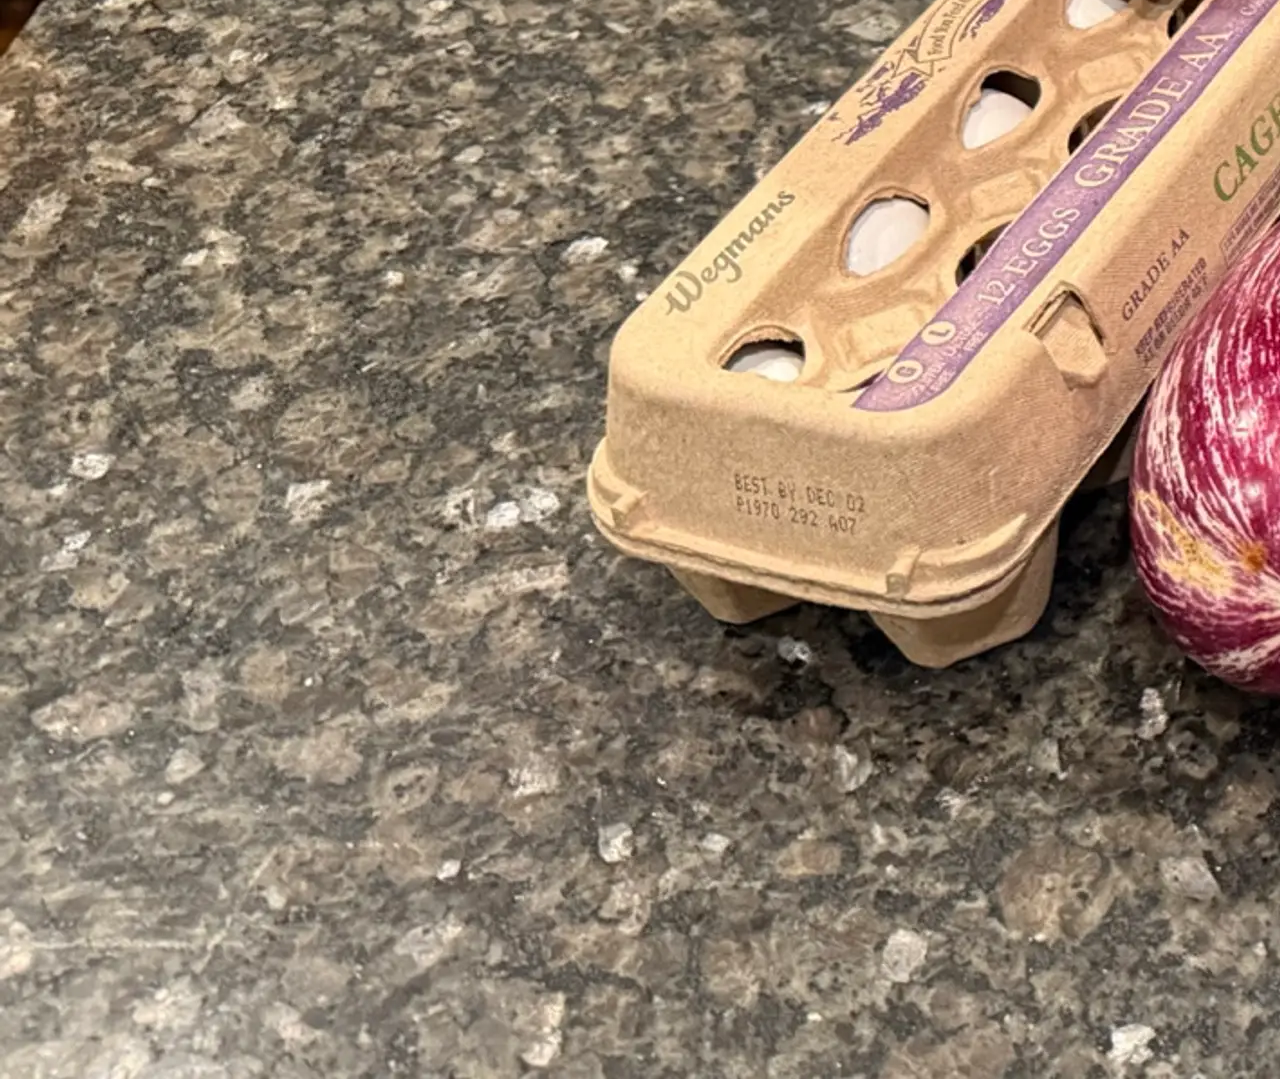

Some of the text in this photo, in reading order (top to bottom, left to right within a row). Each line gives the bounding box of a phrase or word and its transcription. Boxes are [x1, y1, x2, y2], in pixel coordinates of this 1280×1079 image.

[933, 12, 954, 34] You
[924, 33, 946, 56] Food
[976, 27, 1233, 306] 12 EGGS GRADE AA
[664, 188, 796, 316] Wegmans
[1119, 228, 1191, 322] GRADE AA
[733, 473, 866, 513] BEST BY DEC 02
[789, 506, 819, 527] 292
